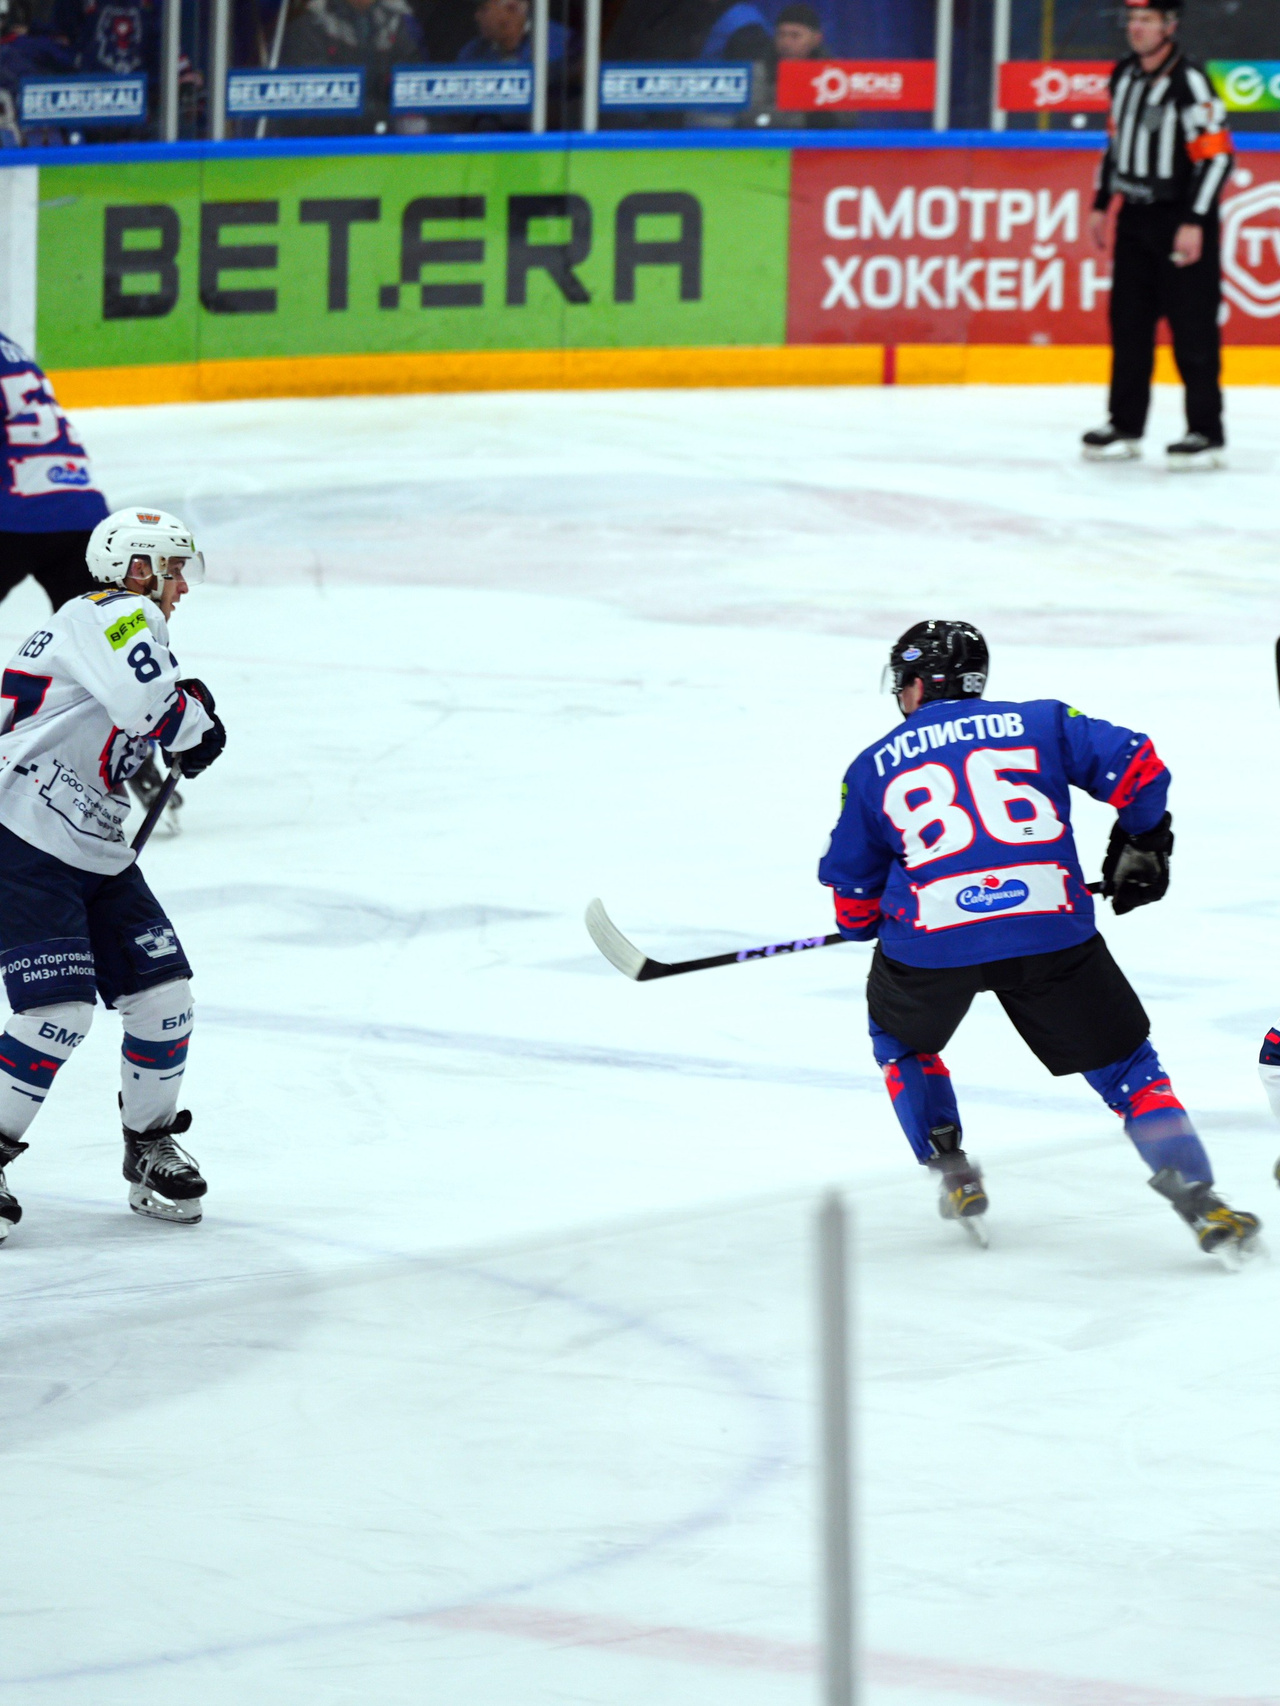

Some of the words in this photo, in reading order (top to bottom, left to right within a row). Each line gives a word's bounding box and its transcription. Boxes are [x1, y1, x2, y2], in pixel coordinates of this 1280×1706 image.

[824, 185, 1080, 243] СМОТРИ
[821, 244, 1065, 311] ХОККЕЙ
[1080, 258, 1113, 311] Н
[127, 641, 163, 684] 8
[873, 712, 1025, 777] ГУСЛИСТОВ
[882, 745, 1067, 871] 86
[960, 889, 1026, 906] Савушкин
